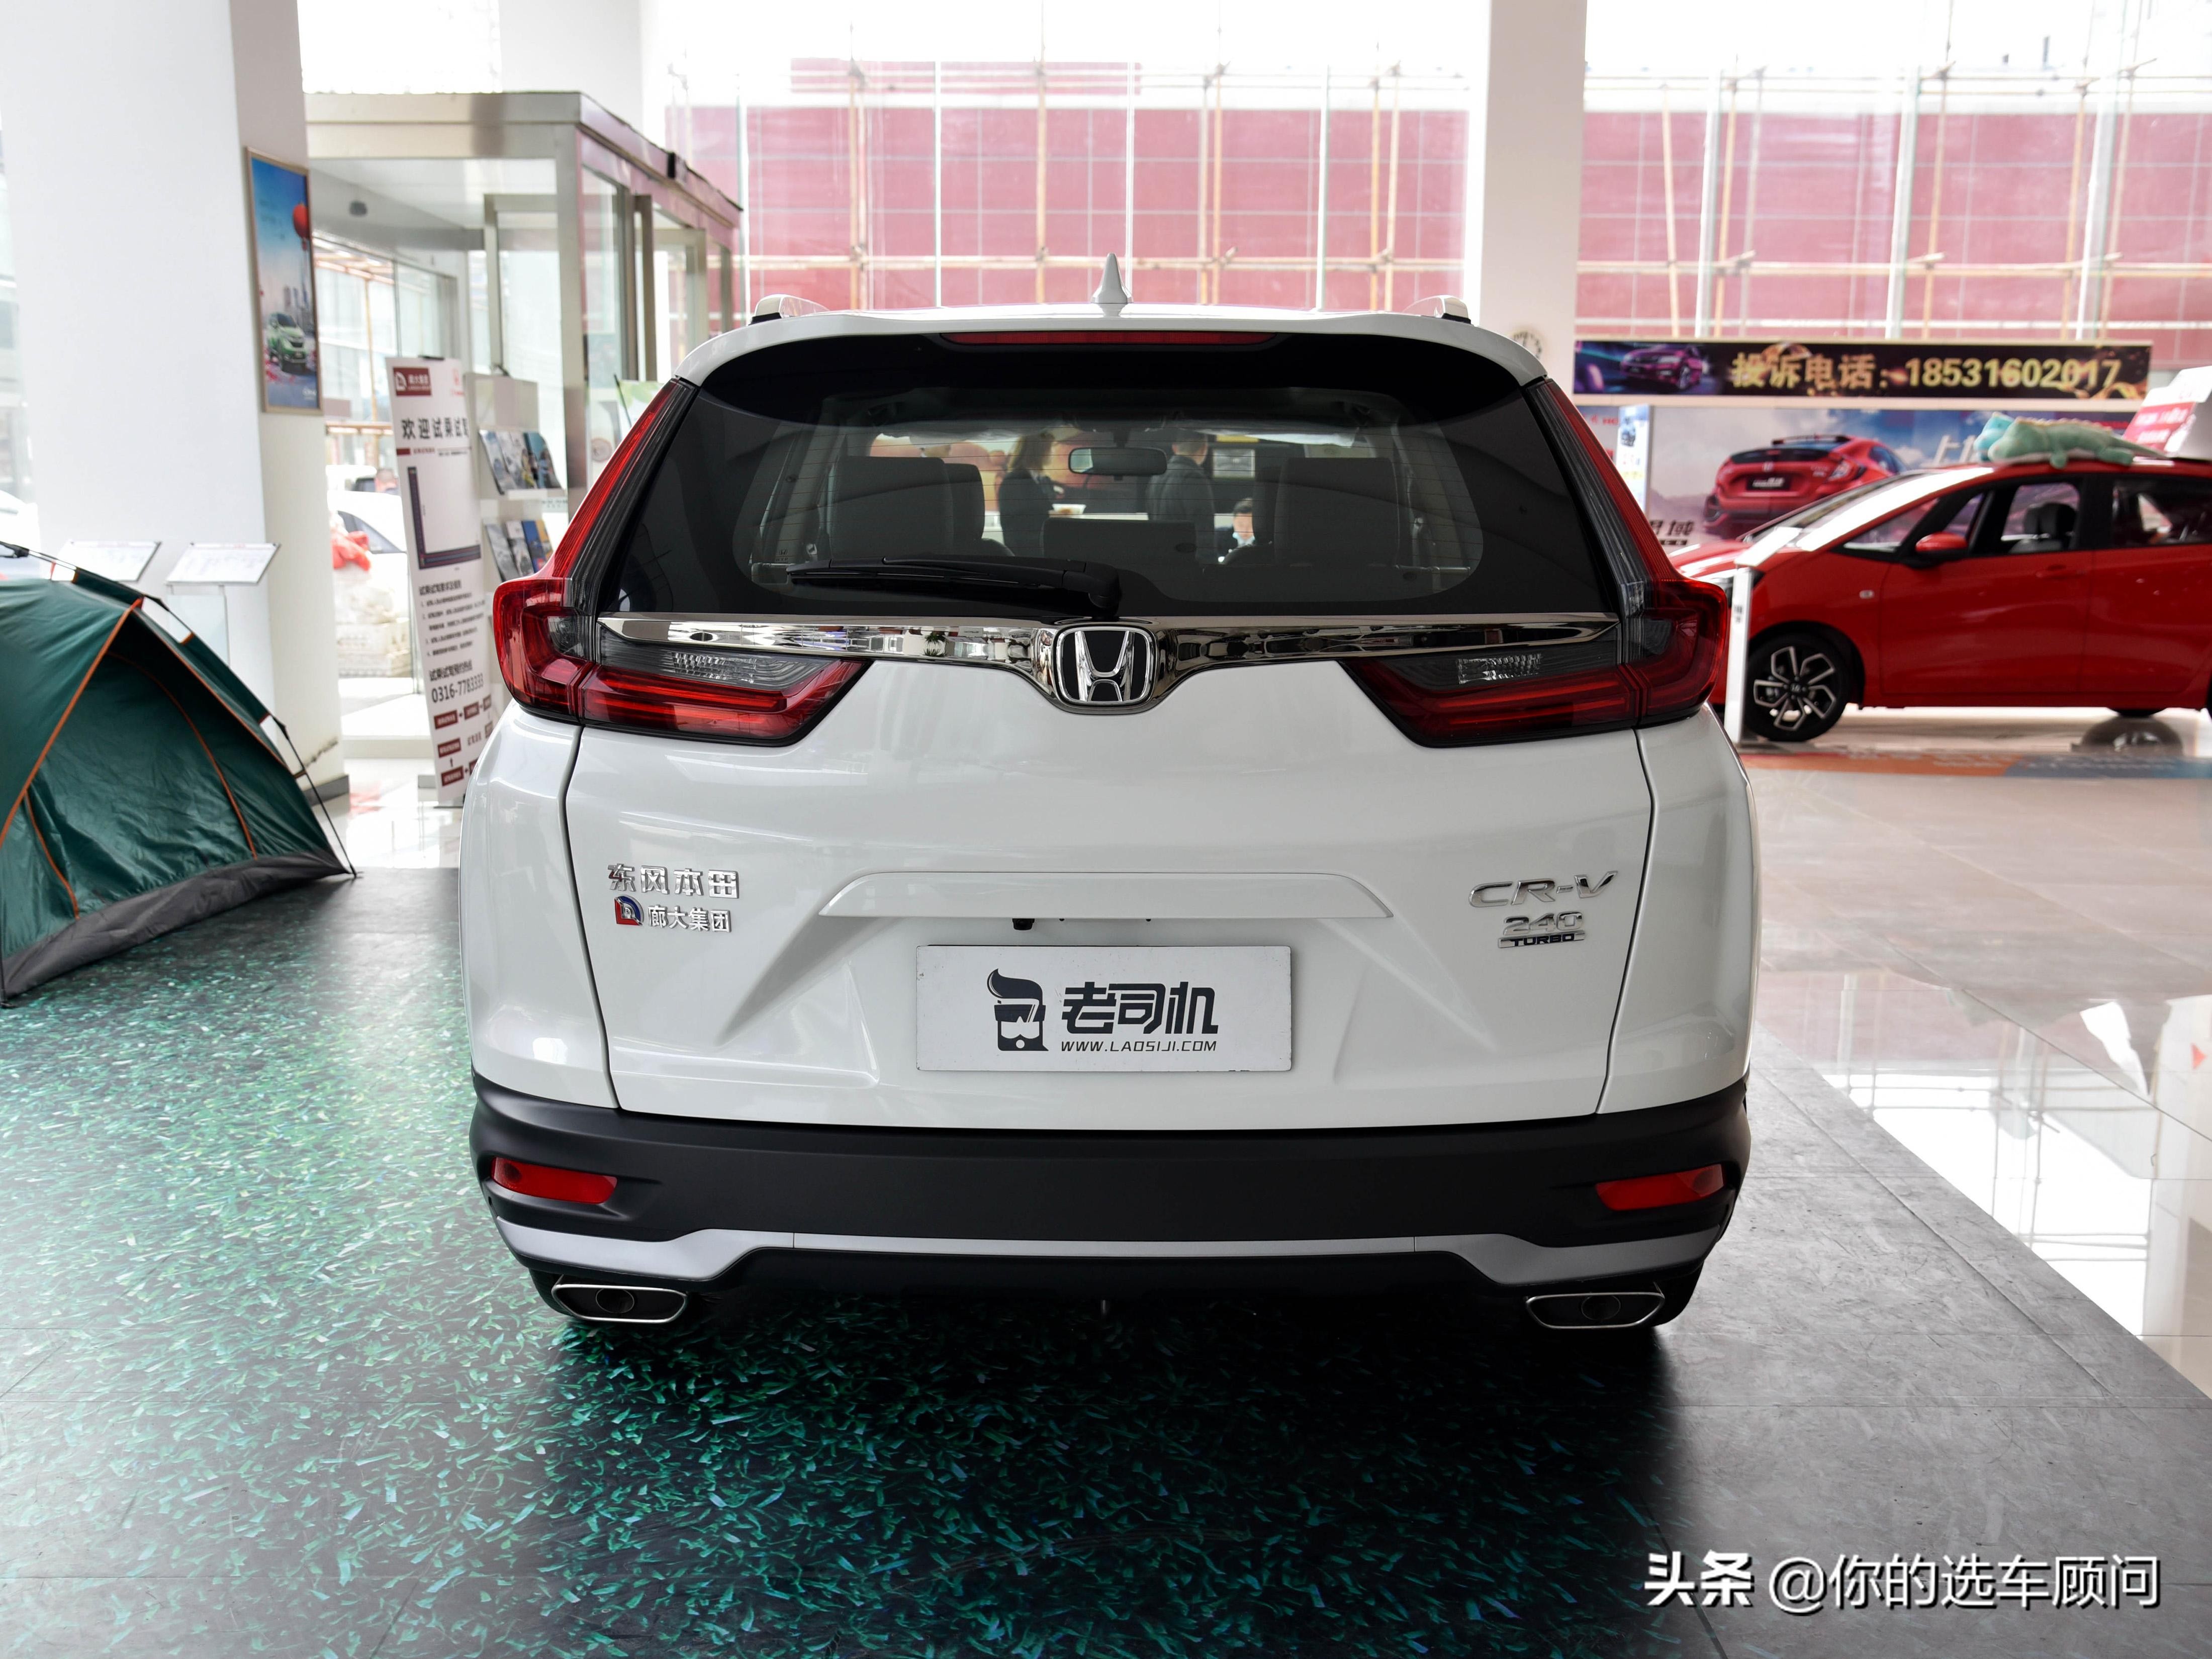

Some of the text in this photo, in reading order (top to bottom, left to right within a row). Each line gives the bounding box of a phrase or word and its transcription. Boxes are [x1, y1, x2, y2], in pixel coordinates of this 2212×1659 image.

[607, 863, 740, 899] 东风本田
[1468, 870, 1618, 908] CR-V
[648, 904, 732, 933] 廊大集团
[1503, 911, 1585, 936] 240
[1510, 933, 1575, 947] TURBO
[1061, 981, 1219, 1035] 老司机
[1061, 1040, 1217, 1052] WWW.LAOSIJI.COM
